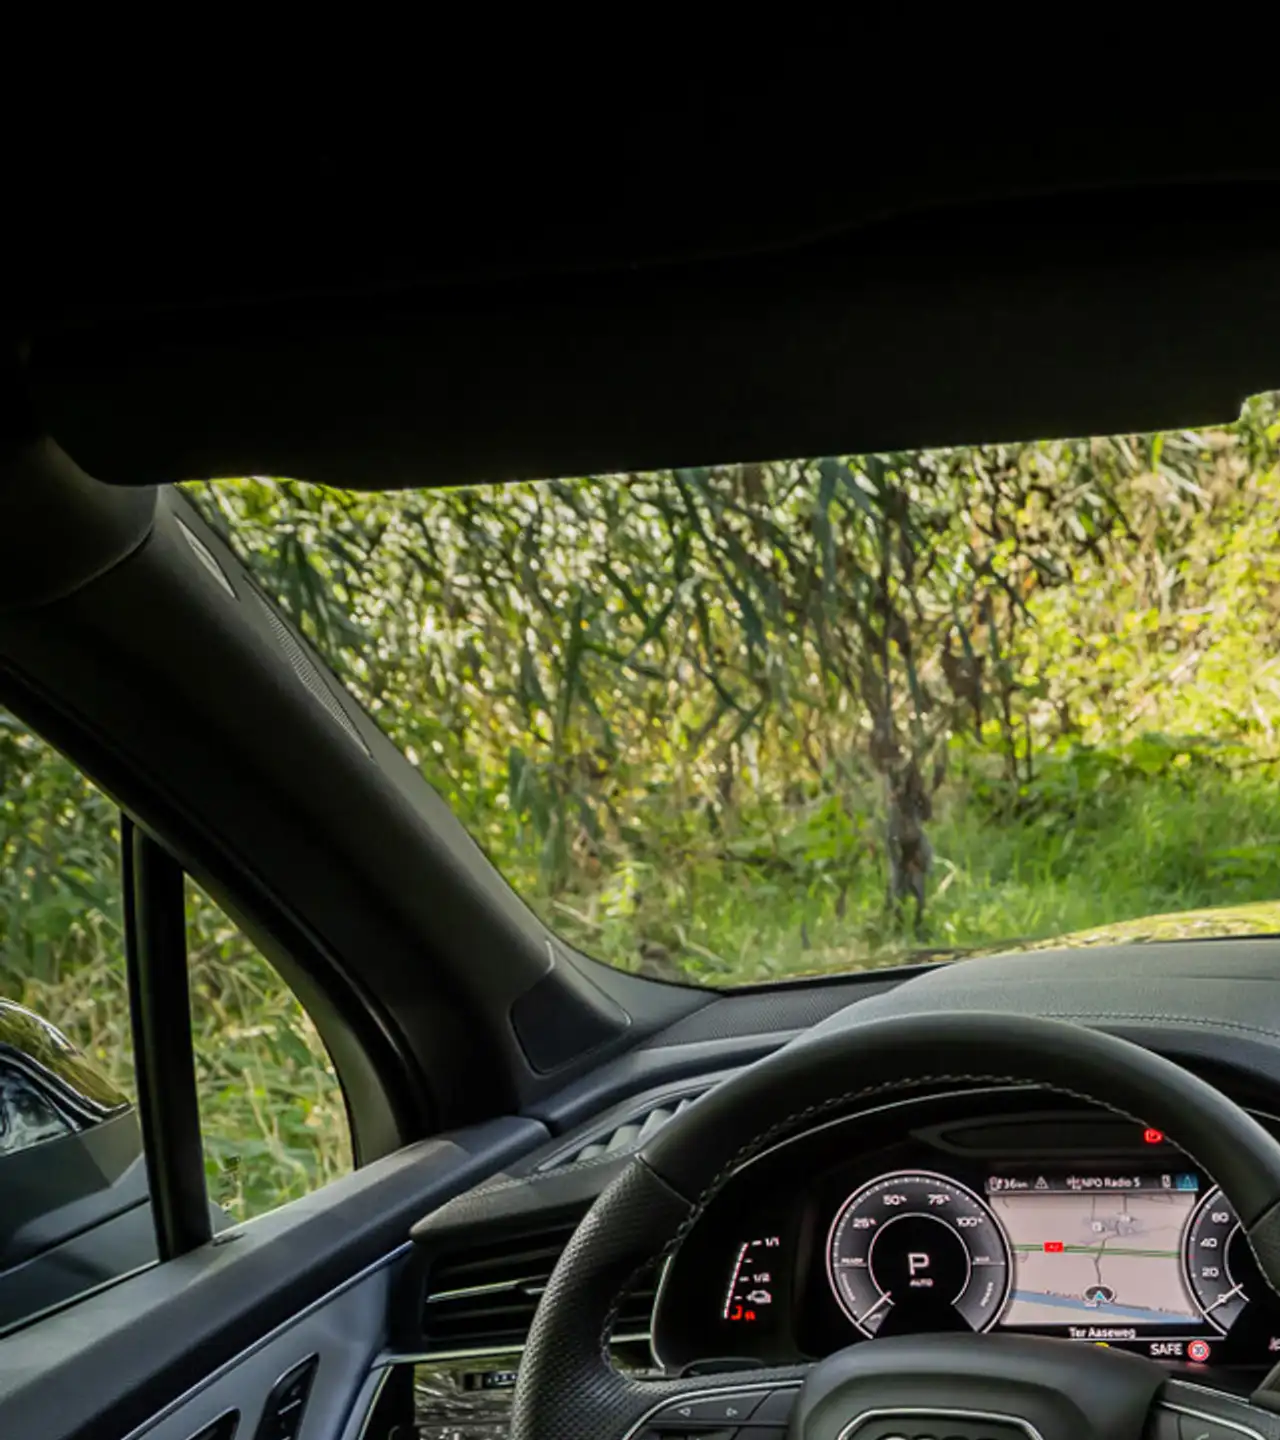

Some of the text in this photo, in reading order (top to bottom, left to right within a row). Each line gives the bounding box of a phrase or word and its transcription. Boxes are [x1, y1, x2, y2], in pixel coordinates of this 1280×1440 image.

[1104, 1178, 1132, 1188] Radio
[1200, 1237, 1217, 1248] 40
[908, 1253, 930, 1275] P
[1202, 1266, 1219, 1278] 20
[1069, 1327, 1087, 1338] Ter
[1151, 1344, 1183, 1355] SAFE
